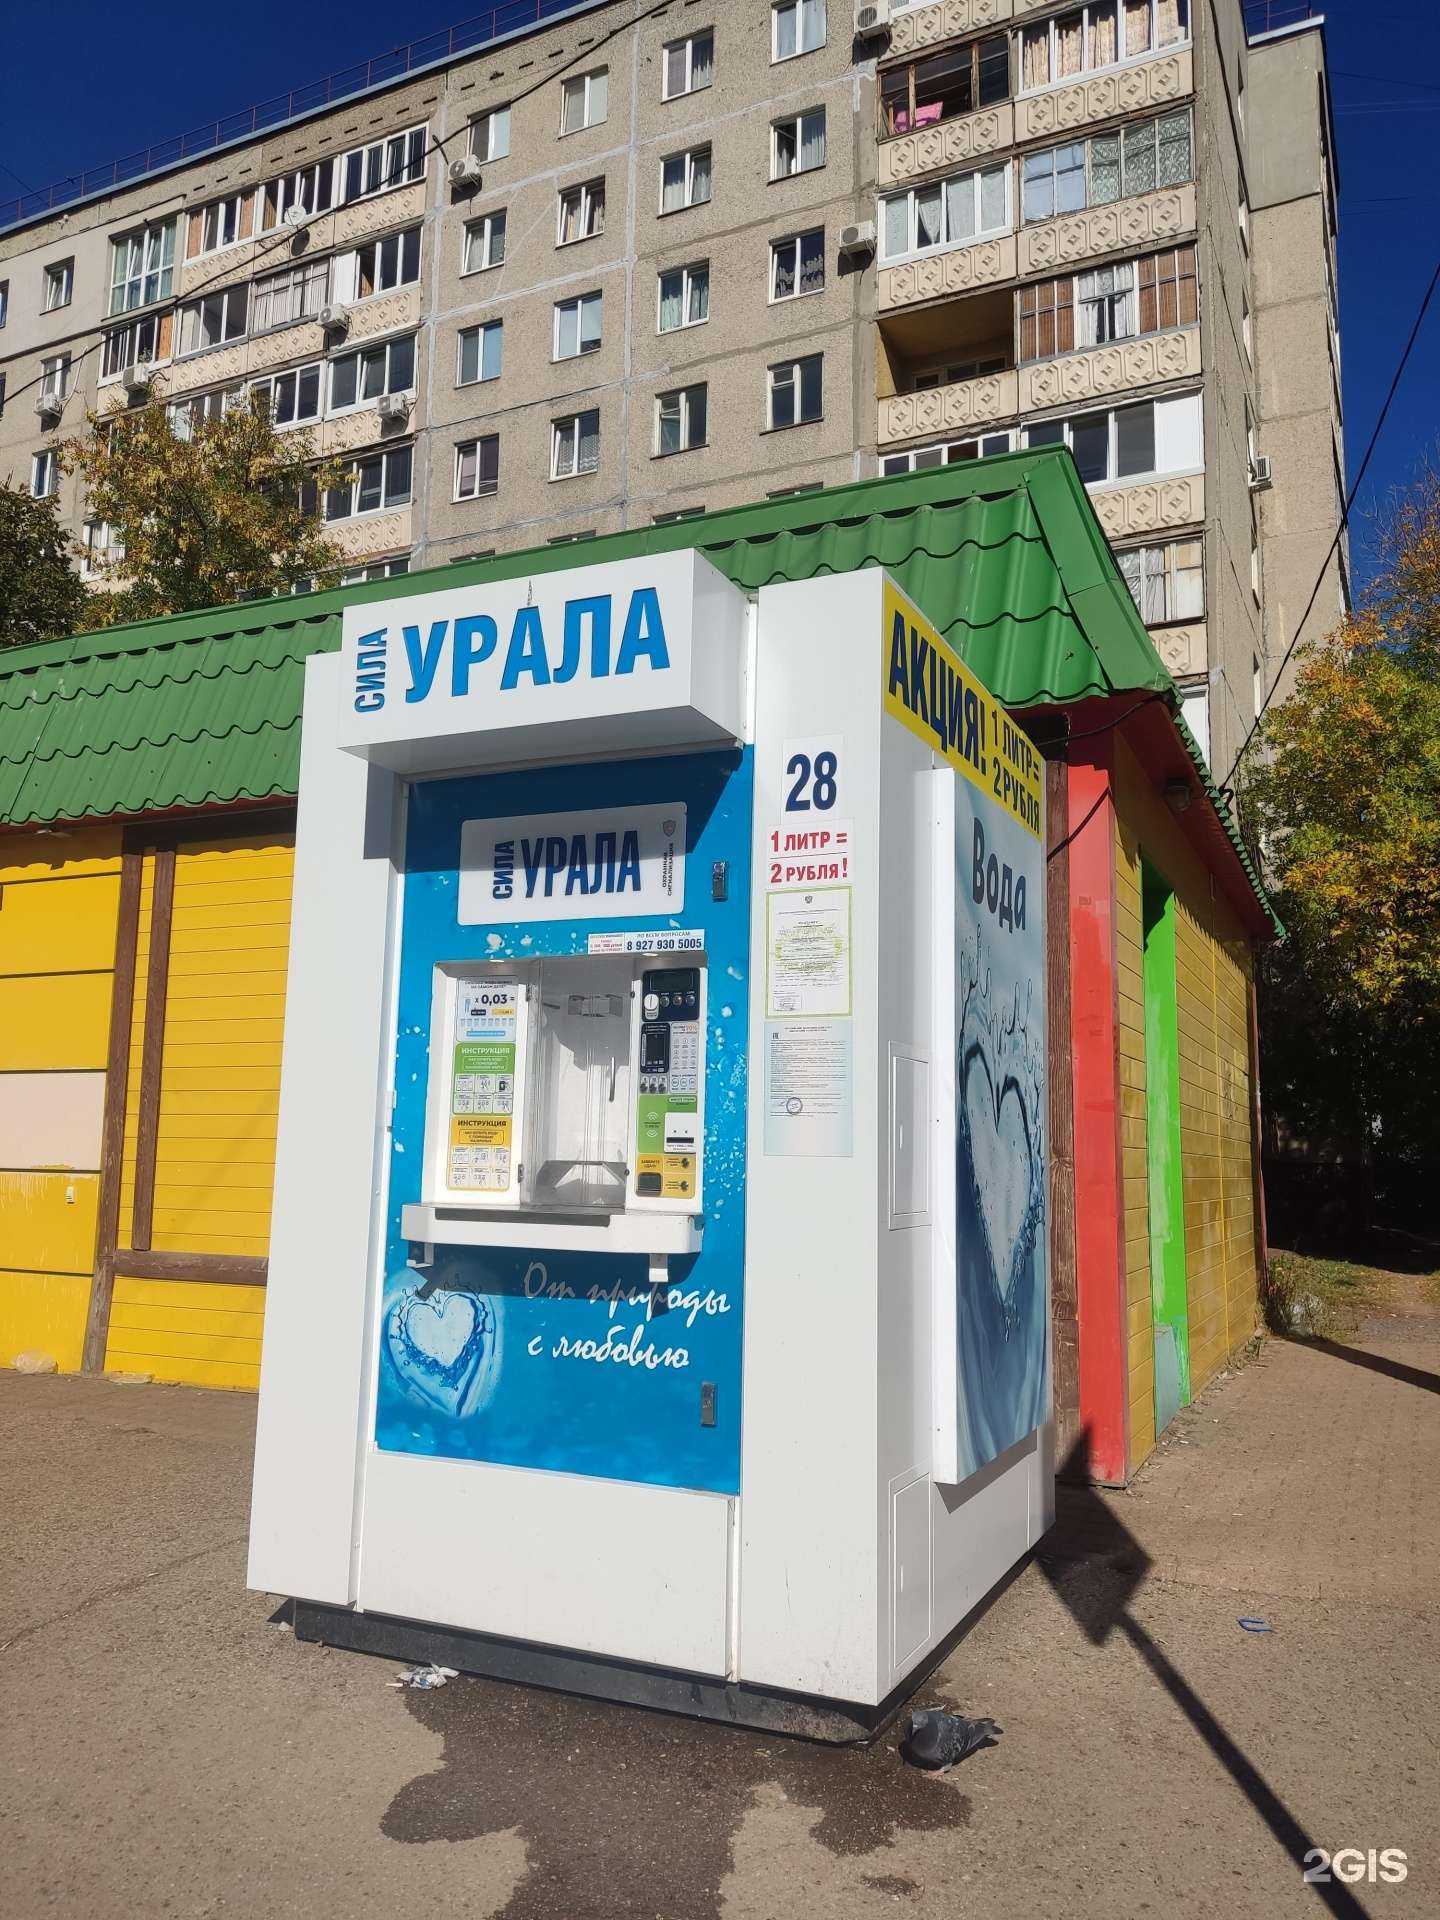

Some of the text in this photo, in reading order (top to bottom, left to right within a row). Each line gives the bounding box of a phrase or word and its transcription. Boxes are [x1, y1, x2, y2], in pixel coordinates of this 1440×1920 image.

[353, 627, 388, 713] СИЛА
[402, 587, 671, 704] УРАЛА
[888, 609, 987, 776] АКЦИЯ!
[992, 710, 998, 746] 1
[785, 751, 838, 812] 28
[492, 840, 515, 899] СИЛА
[521, 830, 642, 898] УРАЛА
[770, 831, 779, 852] 1
[770, 863, 782, 883] 2
[972, 817, 1027, 934] Вода
[627, 942, 633, 951] 8
[636, 940, 653, 950] 927
[657, 939, 675, 949] 930
[678, 938, 702, 948] 5005
[481, 994, 508, 1006] 0,03
[457, 1120, 506, 1128] ИНСТРУКЦИЯ
[524, 1261, 731, 1328] От природы
[527, 1324, 690, 1369] с любовью
